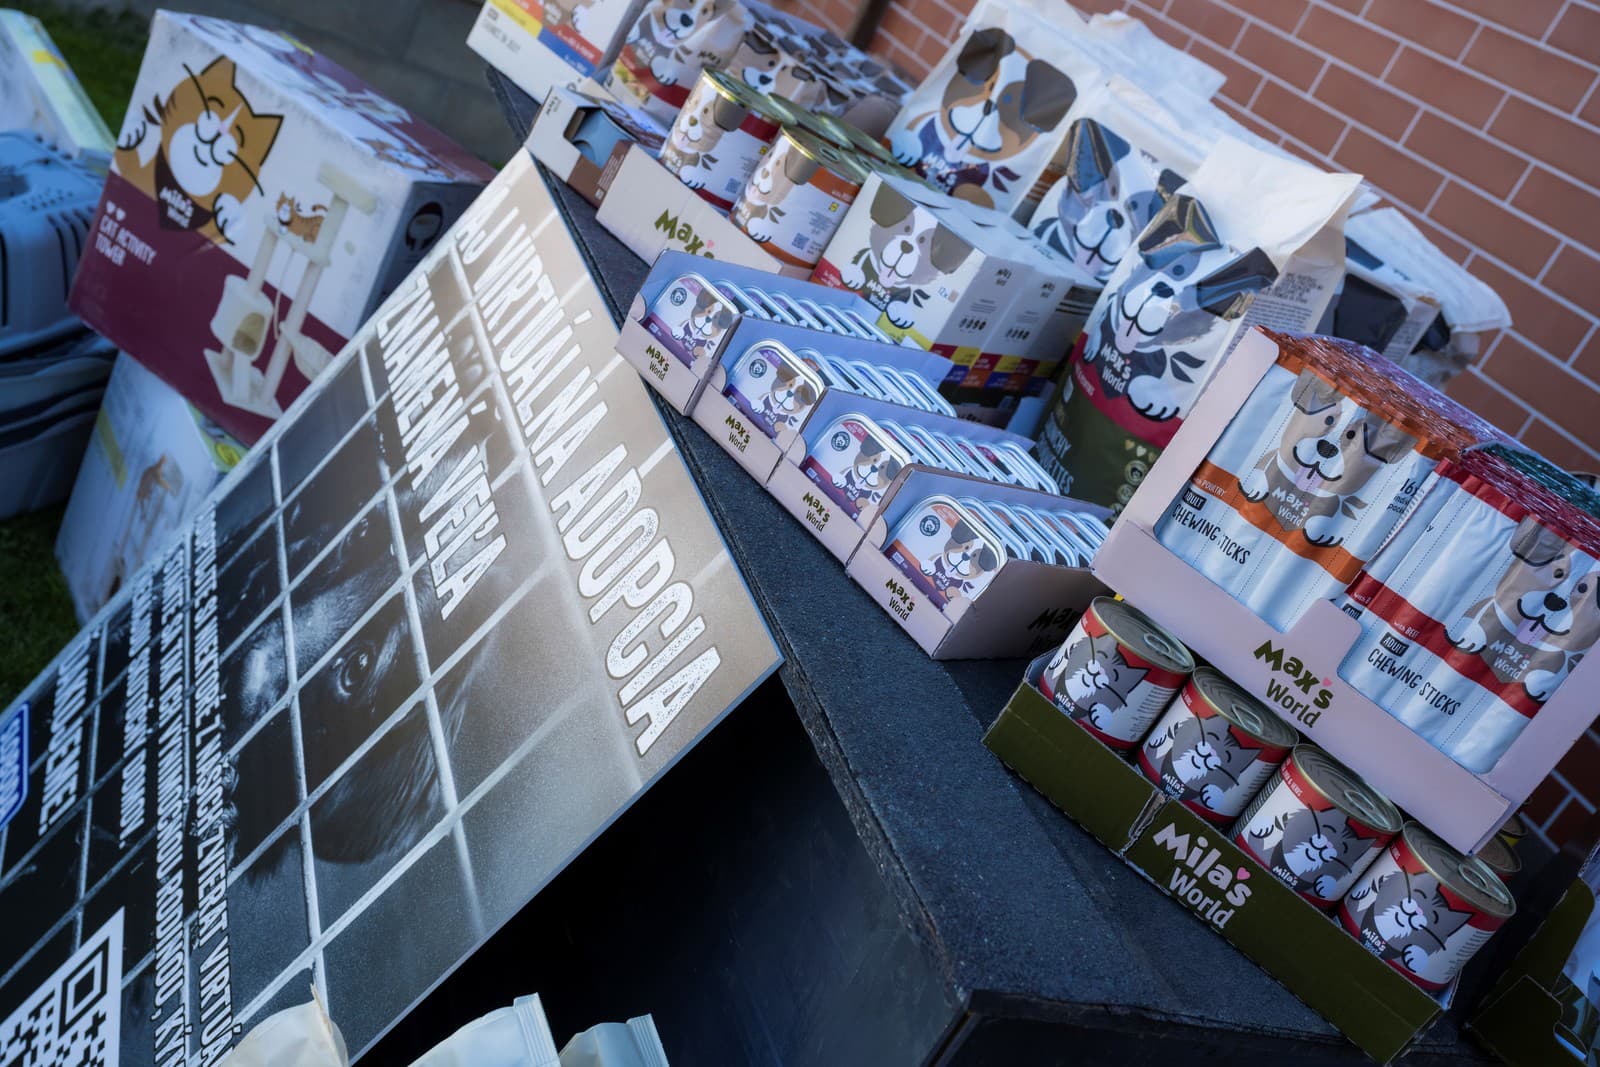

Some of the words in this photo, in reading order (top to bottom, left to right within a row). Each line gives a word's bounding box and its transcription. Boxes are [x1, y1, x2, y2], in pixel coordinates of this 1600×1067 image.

[96, 232, 126, 267] TOWER
[100, 214, 119, 239] CAT
[116, 227, 157, 265] ACTIVITY
[646, 344, 670, 372] Max's
[649, 361, 667, 381] World
[1100, 343, 1132, 380] Max's
[373, 272, 488, 492] ZNAMENÁ
[1102, 366, 1127, 393] World
[725, 415, 751, 444] Max's
[728, 432, 747, 453] World
[471, 222, 609, 488] VIRTUÁLNA
[548, 444, 723, 759] ADOPCIA
[1201, 479, 1227, 497] POULTRY
[1272, 486, 1310, 517] Max's
[802, 492, 831, 523] Max's
[806, 510, 825, 532] World
[1172, 503, 1221, 542] CHEWING
[1278, 504, 1304, 527] World
[417, 444, 508, 622] VEĽA
[193, 592, 219, 631] SI
[886, 578, 915, 613] Max's
[888, 596, 910, 621] World
[159, 610, 182, 654] SA
[1383, 636, 1406, 656] ADULT
[159, 635, 183, 693] TAK
[194, 615, 228, 729] NIEKTORÉ
[1253, 639, 1334, 709] Max's
[1489, 640, 1531, 670] Max's
[1493, 657, 1523, 680] World
[1367, 648, 1423, 689] CHEWING
[1418, 681, 1462, 716] STICKS
[122, 644, 152, 759] SKUTOČNÝ
[158, 675, 183, 729] ICH
[1055, 692, 1075, 712] Mila's
[1266, 678, 1322, 728] World
[38, 629, 103, 838] ĎAKUJEME!
[195, 712, 220, 749] Z
[121, 746, 145, 849] DOMOV.
[157, 712, 188, 882] VÝNIMOČNOU
[192, 731, 230, 838] NAŠICH
[1162, 773, 1186, 794] Mila's
[1153, 822, 1253, 906] Mila's
[1272, 865, 1299, 886] Mila's
[196, 825, 228, 948] ZVIERAT
[1169, 866, 1236, 929] World
[149, 866, 186, 1019] RODINOU,
[1361, 927, 1387, 951] Mila's
